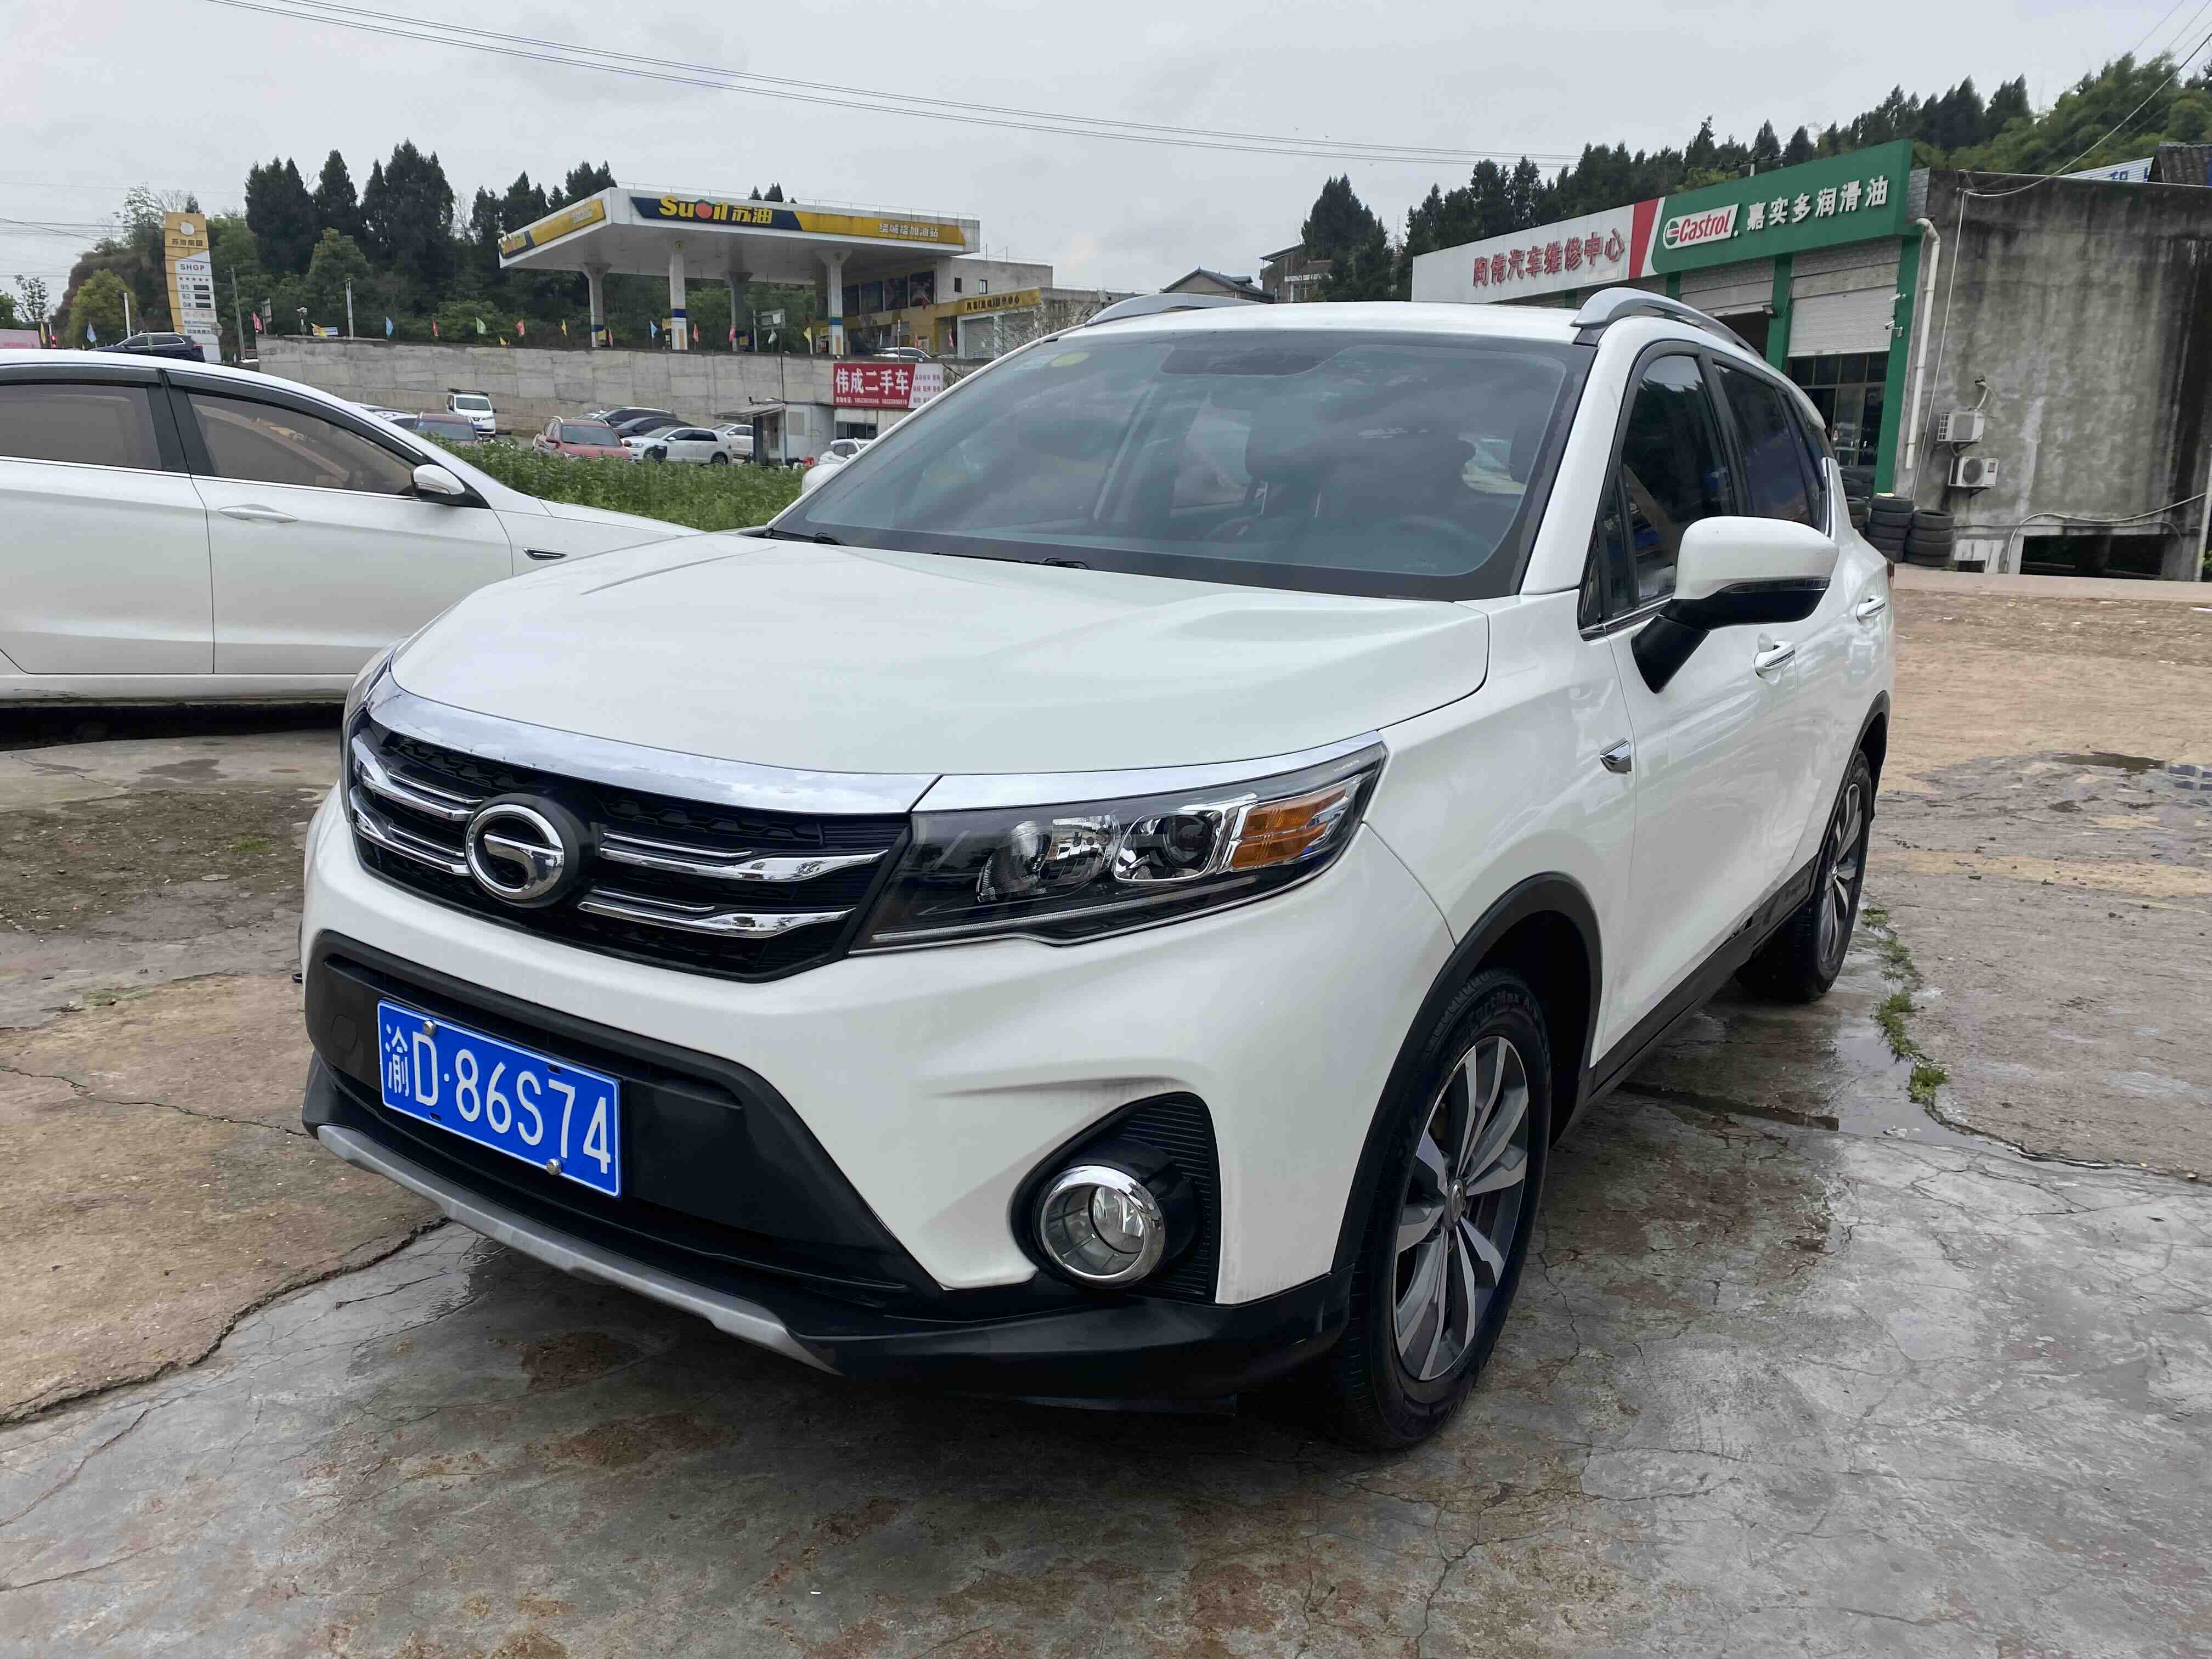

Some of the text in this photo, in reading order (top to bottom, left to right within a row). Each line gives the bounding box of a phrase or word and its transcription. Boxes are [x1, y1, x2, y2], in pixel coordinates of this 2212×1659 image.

[732, 206, 773, 224] 苏油
[1679, 176, 1888, 243] Castrol 嘉实多润滑油
[836, 368, 909, 396] 伟成二手车
